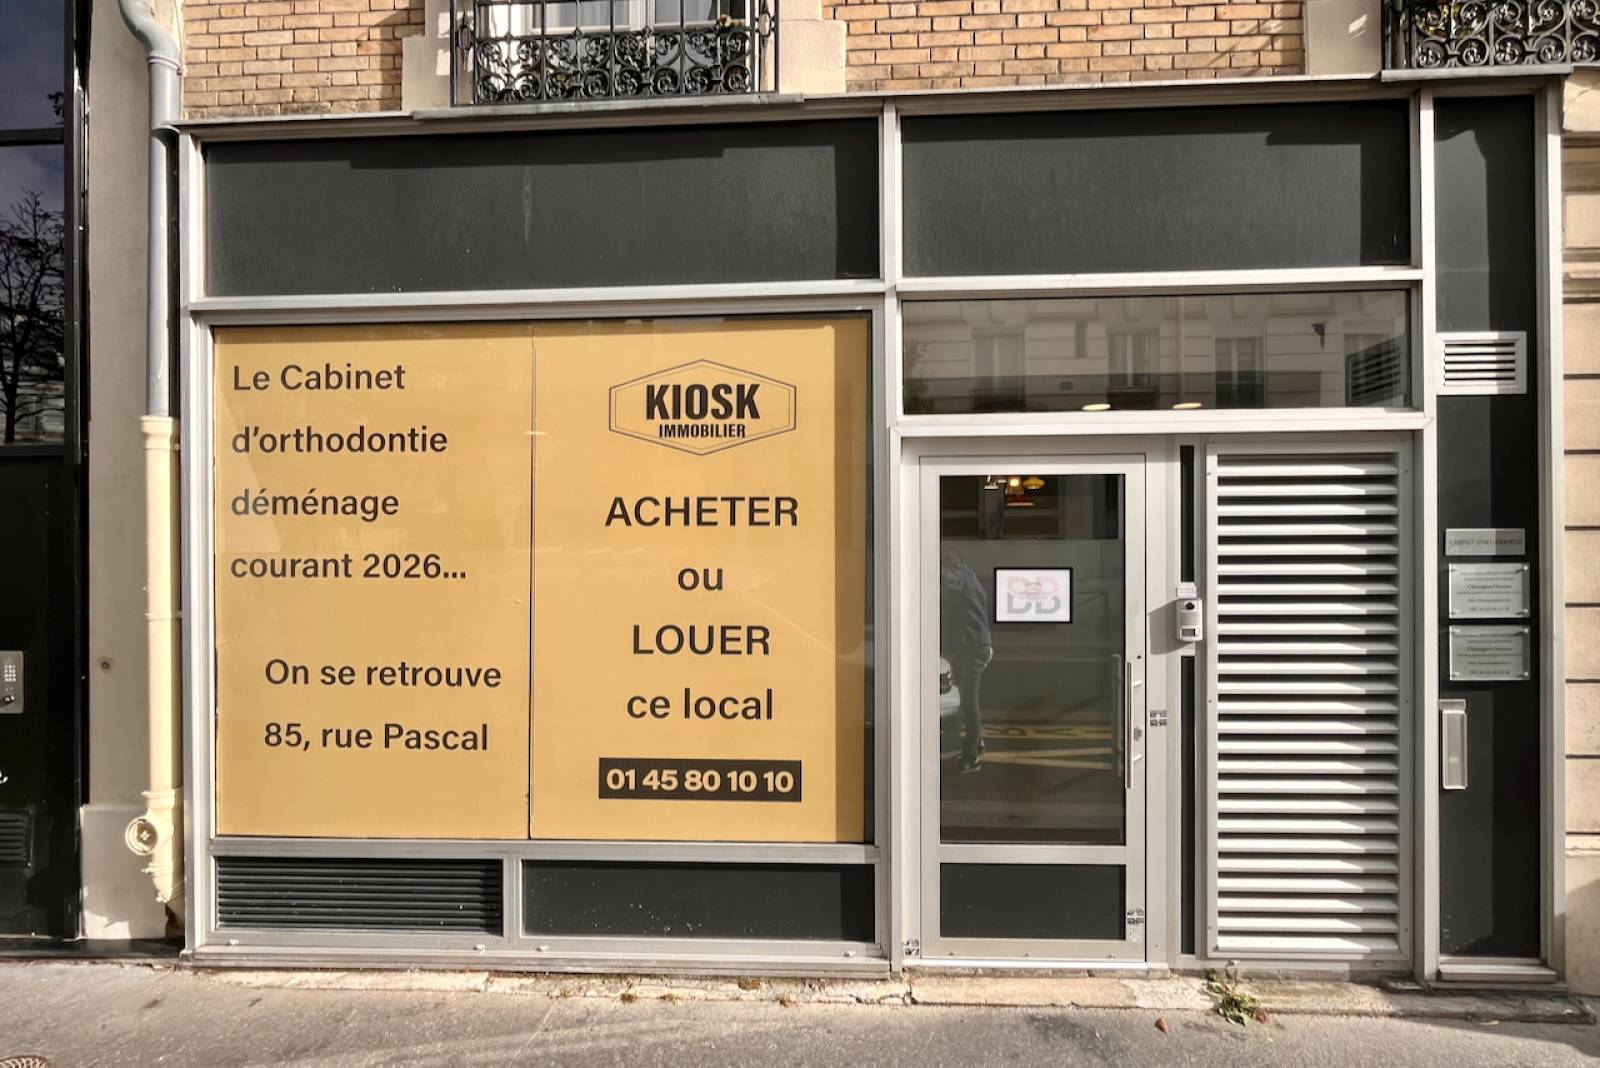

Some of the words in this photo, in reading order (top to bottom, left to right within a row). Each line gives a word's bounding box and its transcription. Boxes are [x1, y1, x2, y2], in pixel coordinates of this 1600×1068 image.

[233, 365, 270, 391] Le
[280, 363, 406, 391] Cabinet
[645, 383, 761, 421] KIOSK
[658, 423, 746, 439] IMMOBILIER
[231, 487, 399, 523] déménage
[604, 496, 799, 527] ACHETER
[230, 554, 353, 579] courant
[677, 567, 723, 591] ou
[633, 624, 770, 656] LOUER
[265, 659, 309, 686] On
[320, 665, 356, 686] se
[366, 661, 502, 688] retrouve
[626, 695, 671, 719] ce
[684, 687, 773, 721] local
[264, 722, 311, 752] 85,
[321, 728, 373, 749] rue
[384, 723, 488, 751] Pascal
[606, 768, 636, 791] 01
[642, 769, 678, 791] 45
[684, 769, 721, 792] 80
[726, 770, 758, 793] 10
[763, 770, 795, 793] 10
